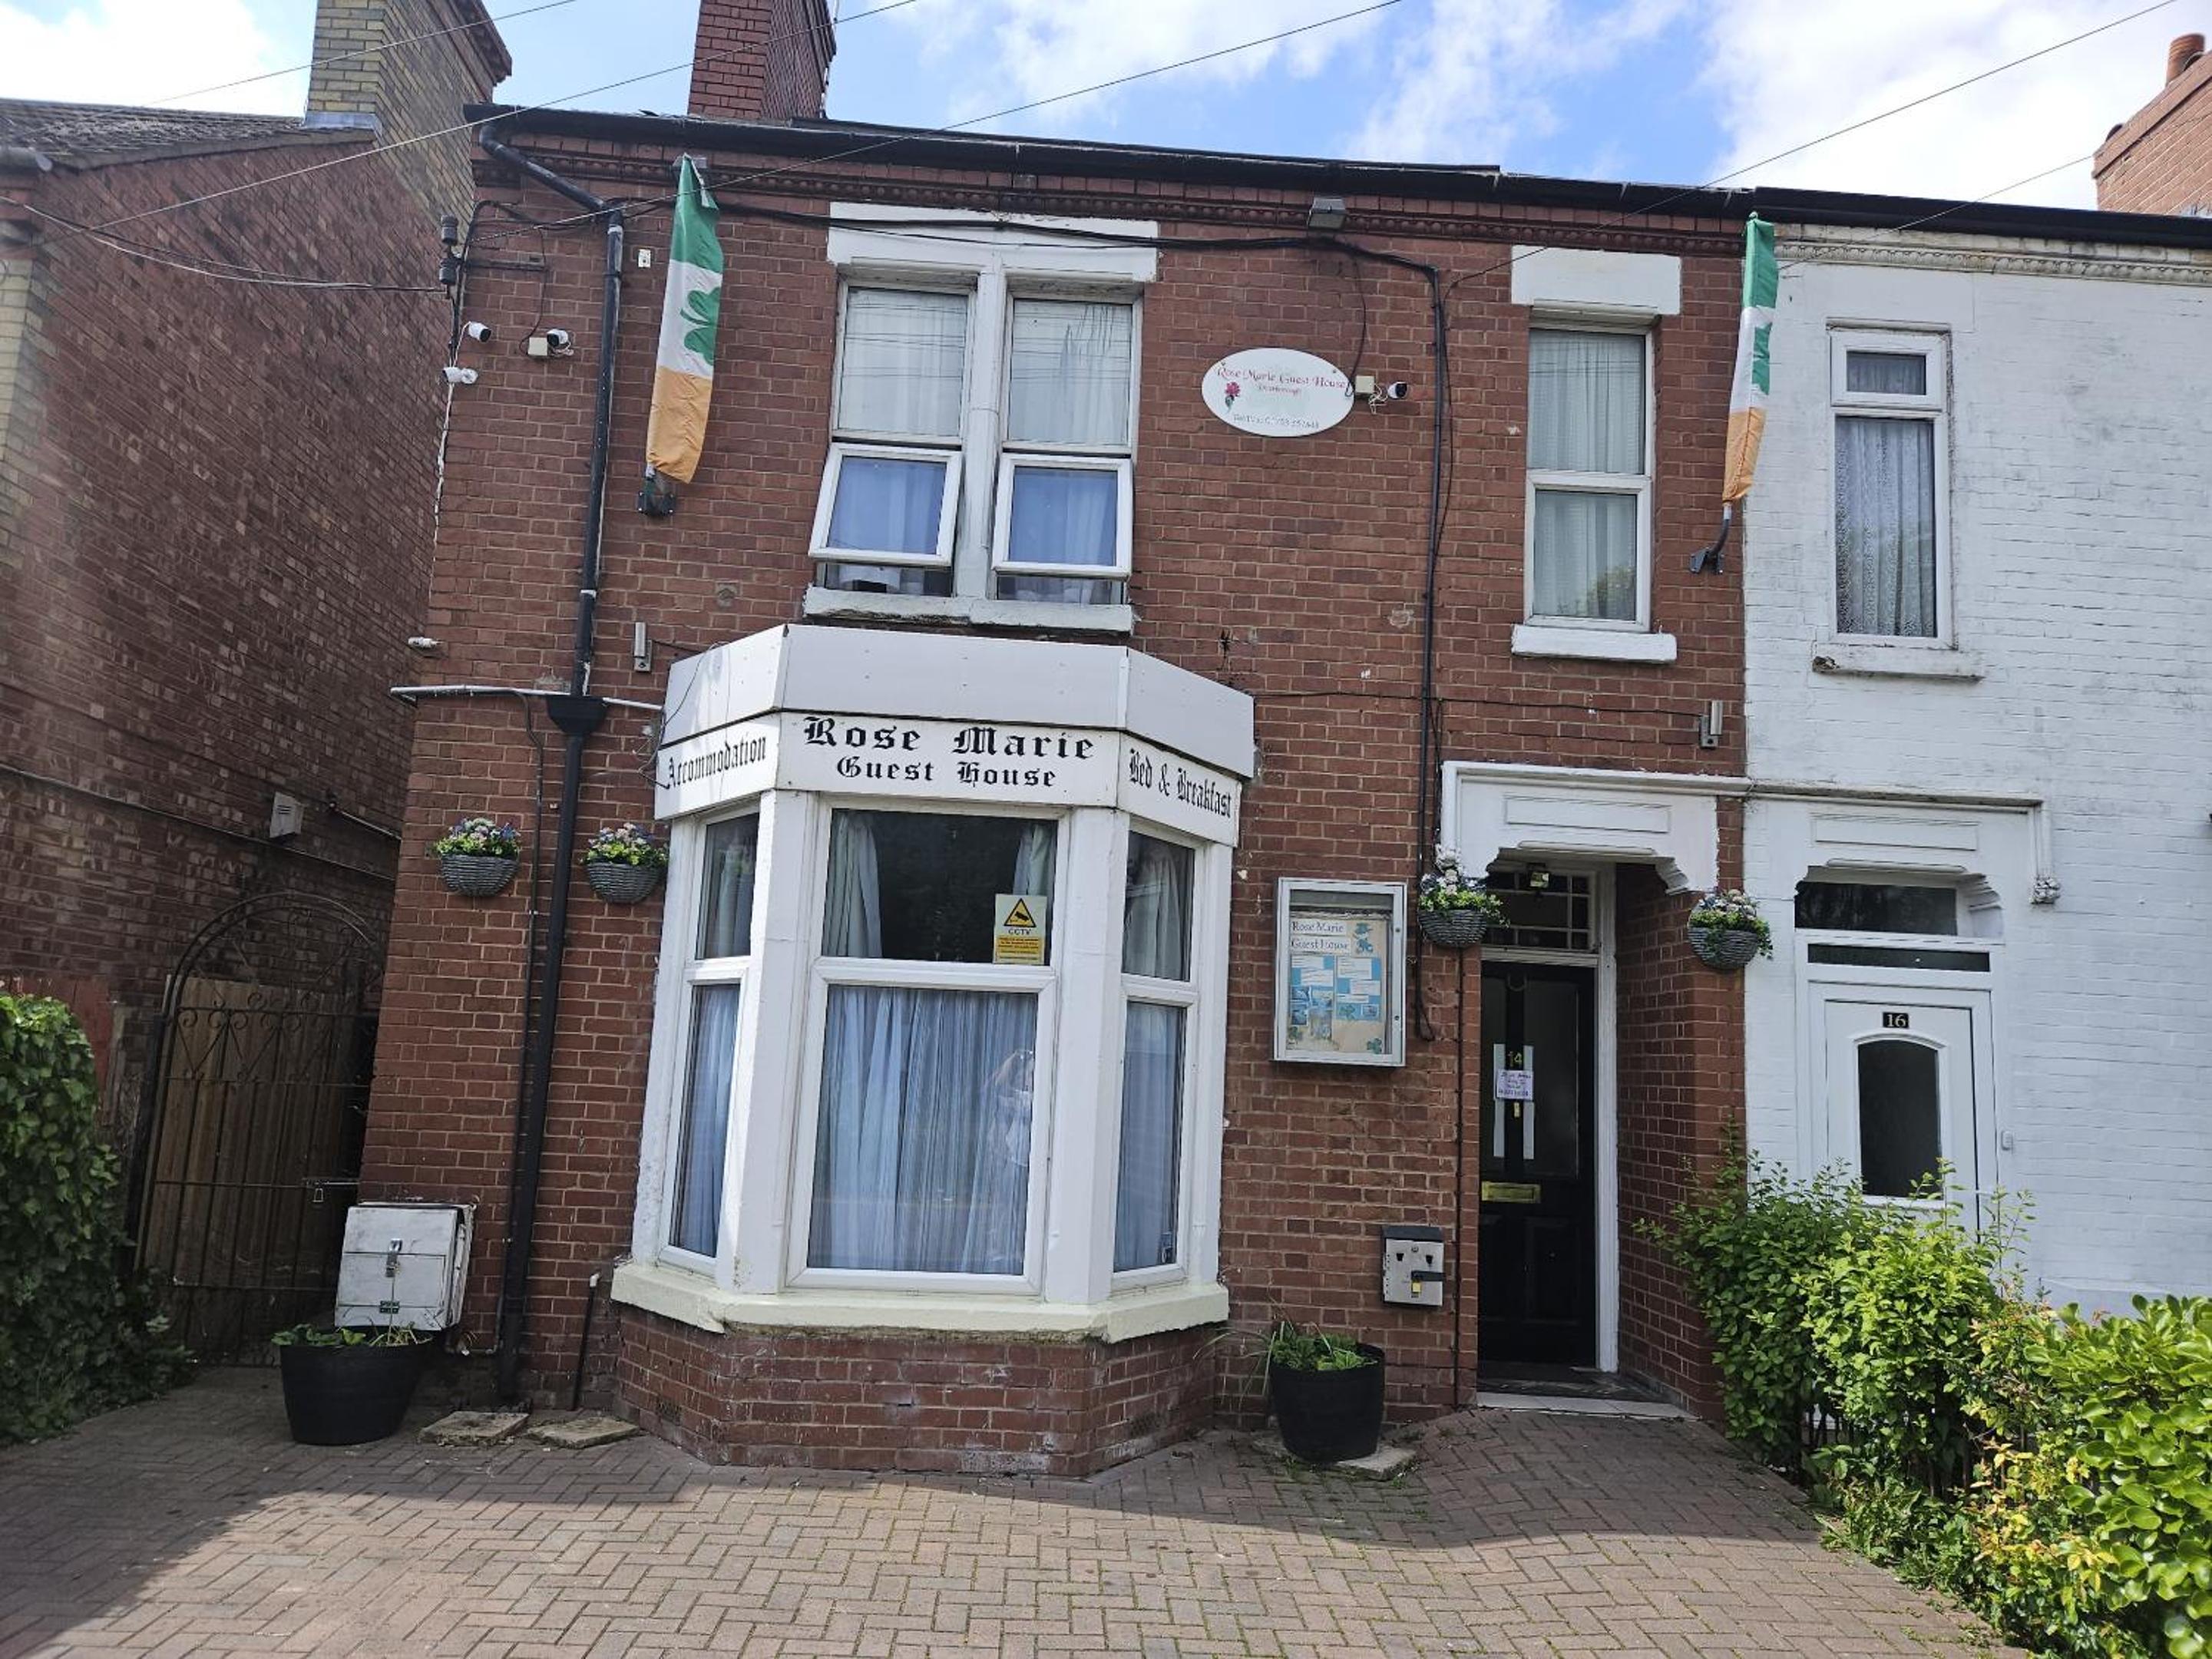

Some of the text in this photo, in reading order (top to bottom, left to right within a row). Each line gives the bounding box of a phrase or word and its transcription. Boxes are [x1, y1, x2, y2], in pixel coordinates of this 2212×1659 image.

[803, 716, 1094, 760] Rose Marie
[669, 734, 767, 788] Accommodation
[837, 755, 1056, 788] Guest House
[1129, 748, 1232, 818] Bed & Breakfast
[1886, 1014, 1906, 1027] 16
[1508, 1051, 1523, 1066] 14
